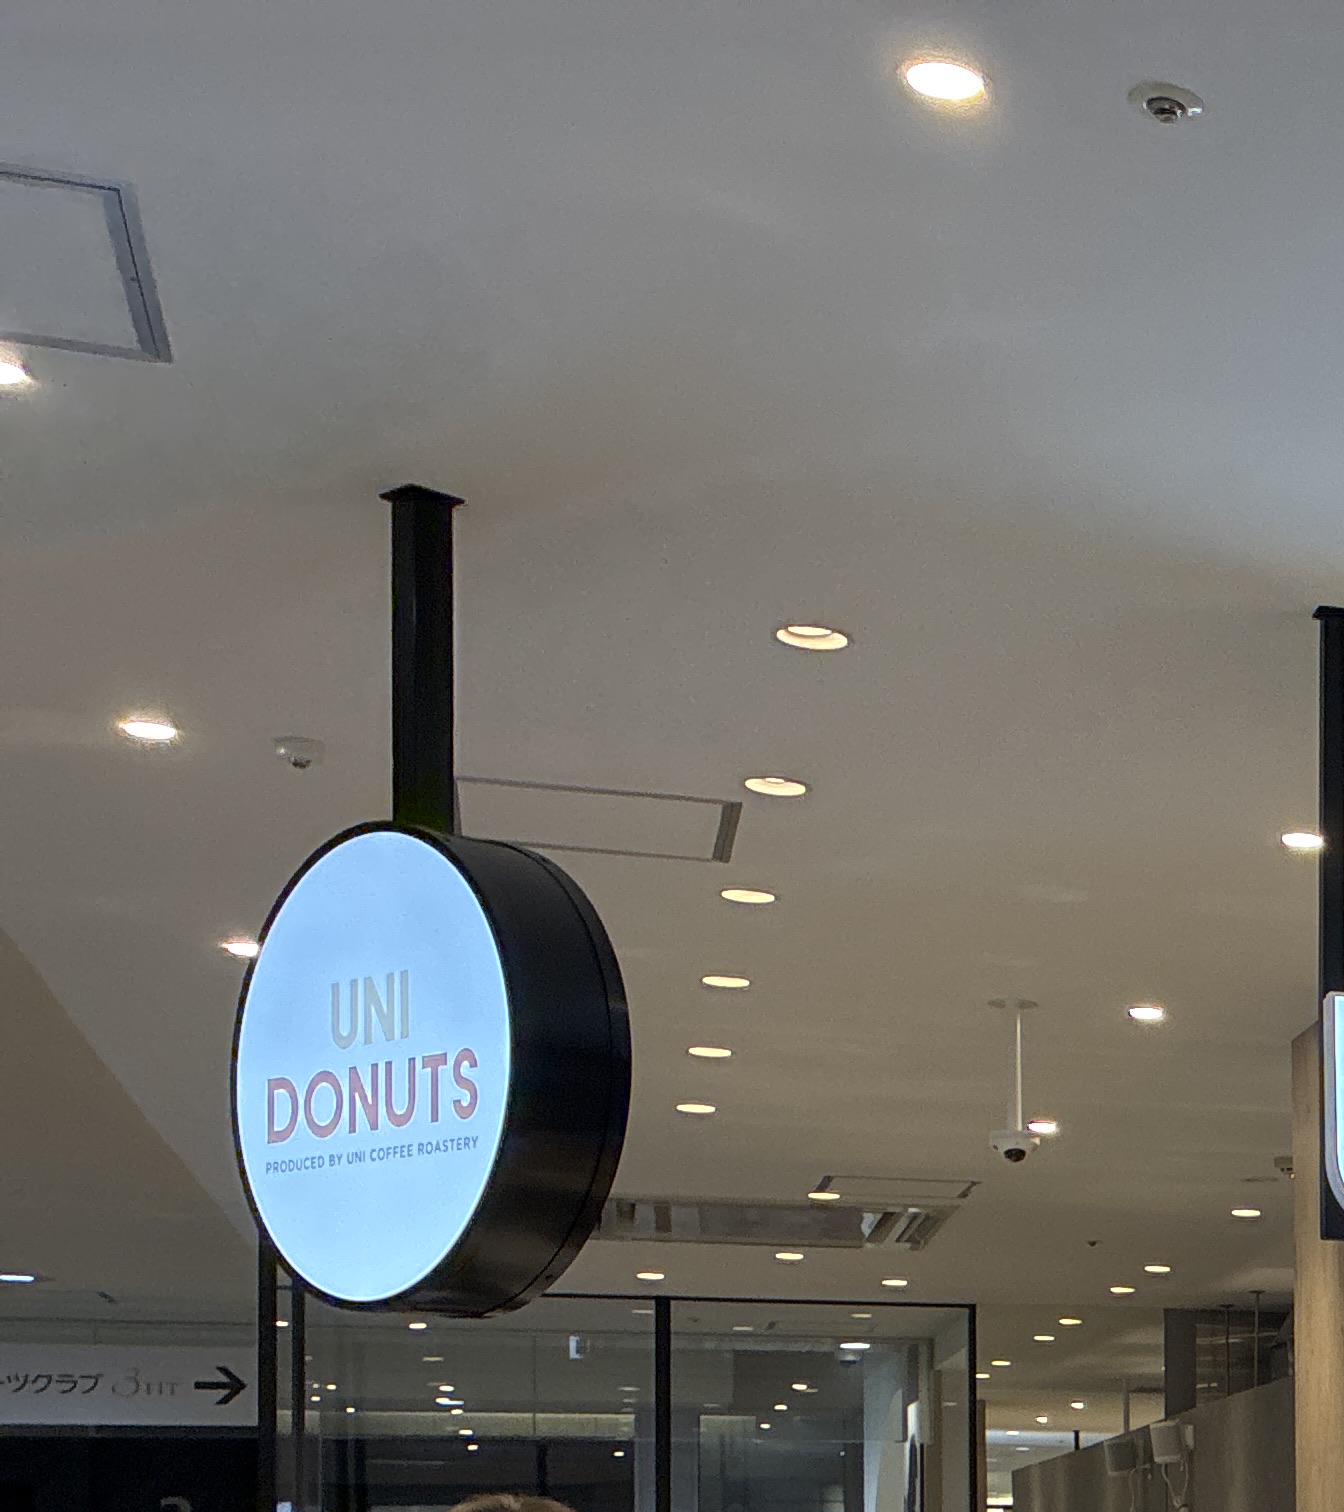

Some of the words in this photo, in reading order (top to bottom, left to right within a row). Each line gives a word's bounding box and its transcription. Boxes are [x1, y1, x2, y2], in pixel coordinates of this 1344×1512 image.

[331, 969, 410, 1049] UNI
[266, 1048, 479, 1144] DONUTS
[265, 1156, 325, 1174] PRODUCED
[328, 1152, 343, 1167] BY
[346, 1150, 366, 1166] UNI
[369, 1144, 413, 1162] COFFEE
[417, 1135, 479, 1156] ROASTERY
